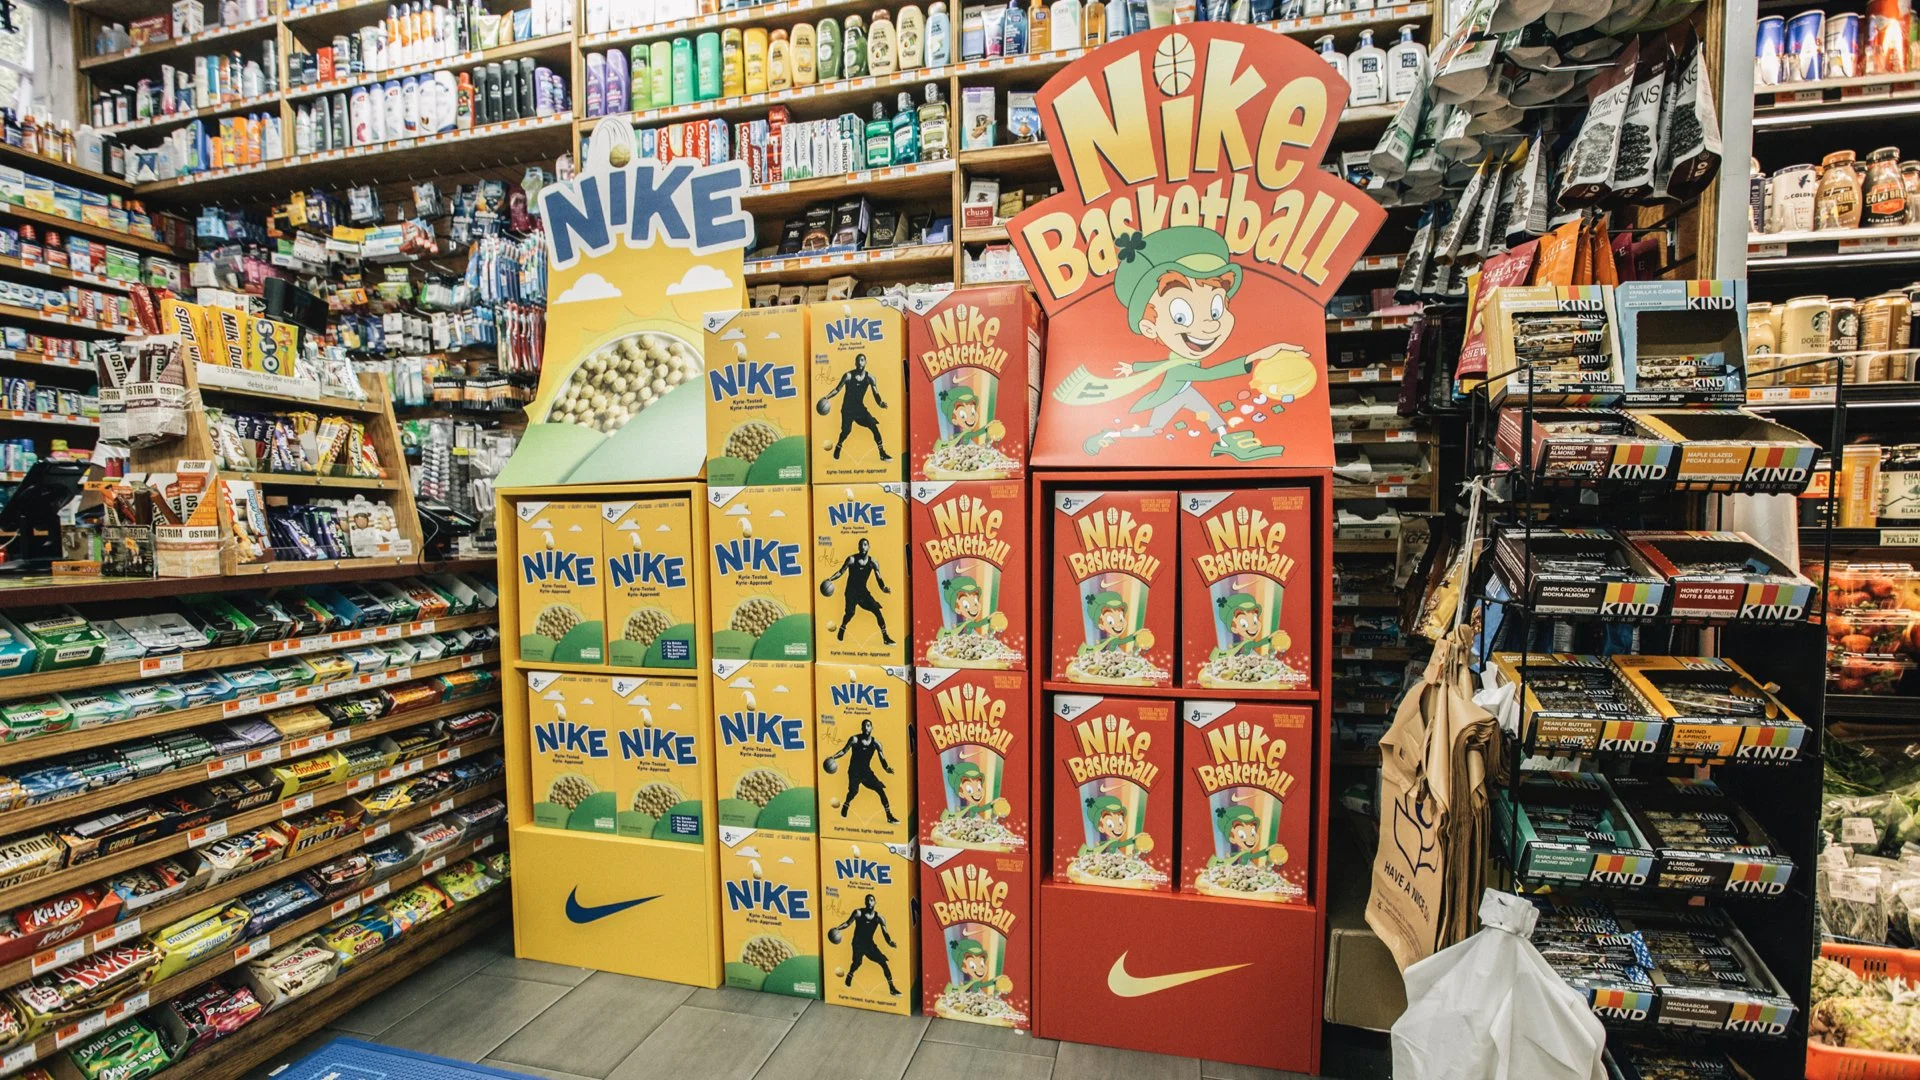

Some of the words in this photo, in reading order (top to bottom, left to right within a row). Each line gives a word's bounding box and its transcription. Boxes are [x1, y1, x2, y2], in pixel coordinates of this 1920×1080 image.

[922, 120, 945, 128] LISTERINE
[1053, 32, 1328, 205] Nike
[544, 165, 747, 263] NIKE
[967, 208, 989, 216] chuao
[1026, 173, 1360, 300] Basketball
[1559, 300, 1604, 311] KIND
[1687, 297, 1735, 310] KIND
[221, 312, 236, 341] Milk
[826, 318, 883, 343] NIKE
[930, 304, 1000, 348] Nike
[922, 343, 1008, 377] Basketball
[1578, 355, 1608, 364] KIND
[709, 361, 797, 401] NIKE
[1580, 373, 1609, 382] KIND
[1693, 378, 1725, 388] KIND
[183, 461, 205, 469] OSTRIM
[1569, 463, 1594, 471] KIND
[1608, 465, 1667, 480] KIND
[1745, 467, 1806, 483] KIND
[828, 502, 886, 527] NIKE
[933, 494, 1002, 539] Nike
[157, 528, 183, 538] OSTRIM
[189, 529, 216, 538] OSTRIM
[1078, 507, 1153, 554] Nike
[1206, 506, 1286, 554] Nike
[715, 539, 801, 576] NIKE
[925, 534, 1011, 566] Basketball
[523, 551, 596, 586] NIKE
[609, 552, 686, 587] NIKE
[1069, 548, 1160, 581] Basketball
[1198, 547, 1295, 582] Basketball
[1601, 603, 1658, 616] KIND
[1740, 605, 1803, 620] KIND
[58, 650, 90, 658] LISTERINE
[314, 657, 335, 666] Trident
[1559, 660, 1605, 668] KIND
[1685, 663, 1733, 672] KIND
[232, 670, 255, 681] Trident
[272, 667, 293, 678] Trident
[128, 686, 159, 698] Trident
[180, 681, 209, 694] Trident
[831, 683, 889, 708] NIKE
[70, 695, 106, 710] Trident
[342, 703, 362, 713] TAKE
[937, 683, 1006, 728] Nike
[1595, 703, 1627, 712] KIND
[11, 709, 44, 721] Trident
[13, 724, 50, 738] Trident
[719, 711, 805, 750] NIKE
[930, 720, 1014, 752] Basketball
[1077, 714, 1151, 761] Nike
[535, 722, 608, 757] NIKE
[619, 728, 696, 764] NIKE
[1208, 721, 1287, 770] Nike
[1599, 739, 1656, 754] KIND
[1737, 745, 1797, 760] KIND
[293, 760, 331, 776] Goodbar
[1068, 753, 1159, 788] Basketball
[1198, 762, 1295, 797] Basketball
[1555, 780, 1600, 790] KIND
[238, 791, 272, 809] HEATH
[1696, 813, 1728, 821] KIND
[109, 835, 136, 849] COOKIE
[1585, 831, 1615, 842] KIND
[1704, 836, 1737, 845] KIND
[835, 859, 892, 885] NIKE
[1384, 861, 1403, 888] HAVE
[1404, 882, 1411, 894] A
[1589, 870, 1647, 886] KIND
[941, 864, 1008, 908] Nike
[1725, 879, 1785, 895] KIND
[726, 880, 810, 919] NIKE
[933, 900, 1016, 933] Basketball
[167, 918, 217, 944] Butterfinger
[1598, 935, 1632, 946] KIND
[65, 947, 145, 990] TWIX
[1712, 971, 1747, 982] KIND
[1667, 1001, 1709, 1009] MADAGASCAR
[1725, 1018, 1786, 1035] KIND
[79, 1036, 114, 1059] Mike
[121, 1024, 139, 1038] Ike
[102, 1059, 137, 1078] Mike
[141, 1048, 161, 1063] Ike
